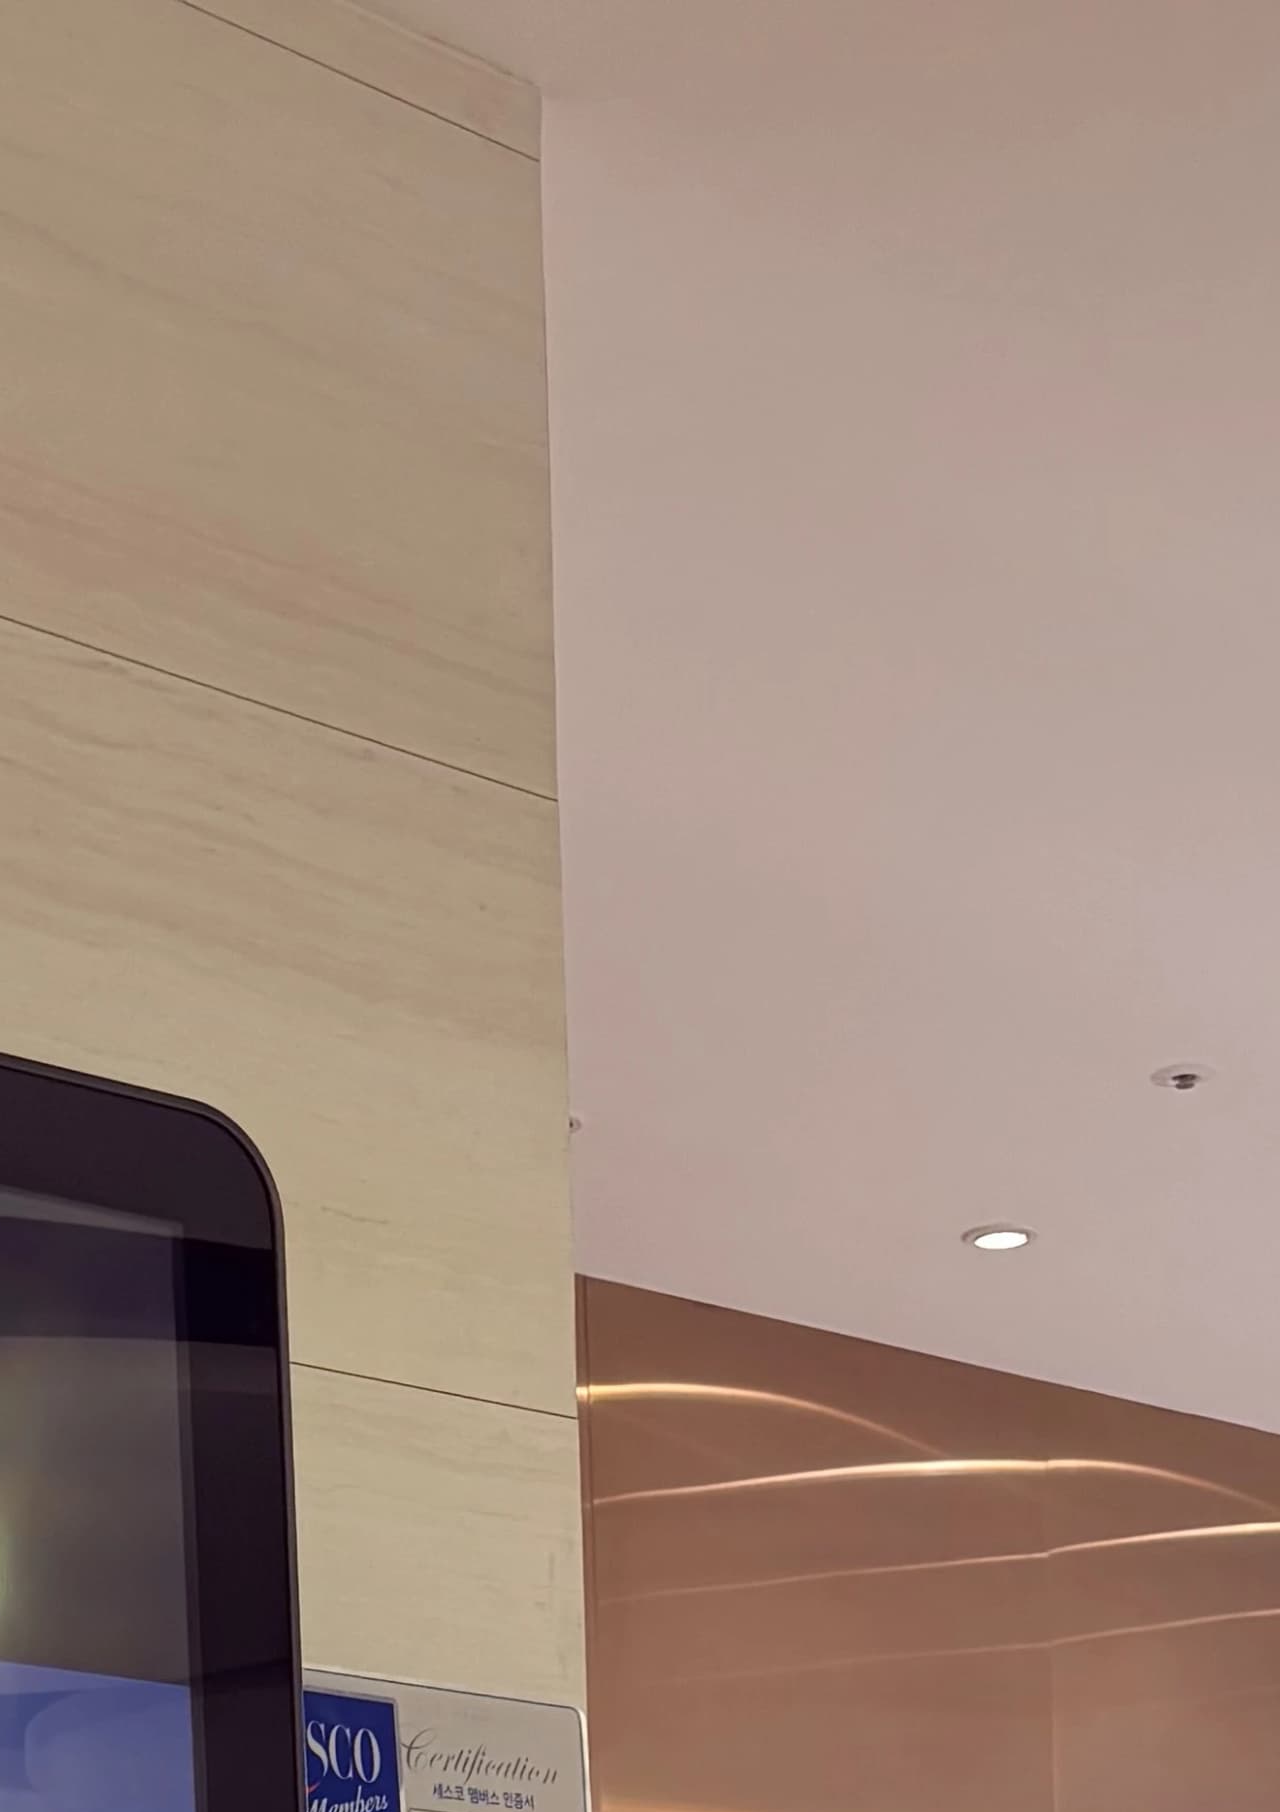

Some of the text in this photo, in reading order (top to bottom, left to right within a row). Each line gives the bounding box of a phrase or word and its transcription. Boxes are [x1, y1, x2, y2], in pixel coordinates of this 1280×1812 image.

[401, 1727, 557, 1785] Certification
[432, 1784, 535, 1811] 세스코 멤버스 인증서
